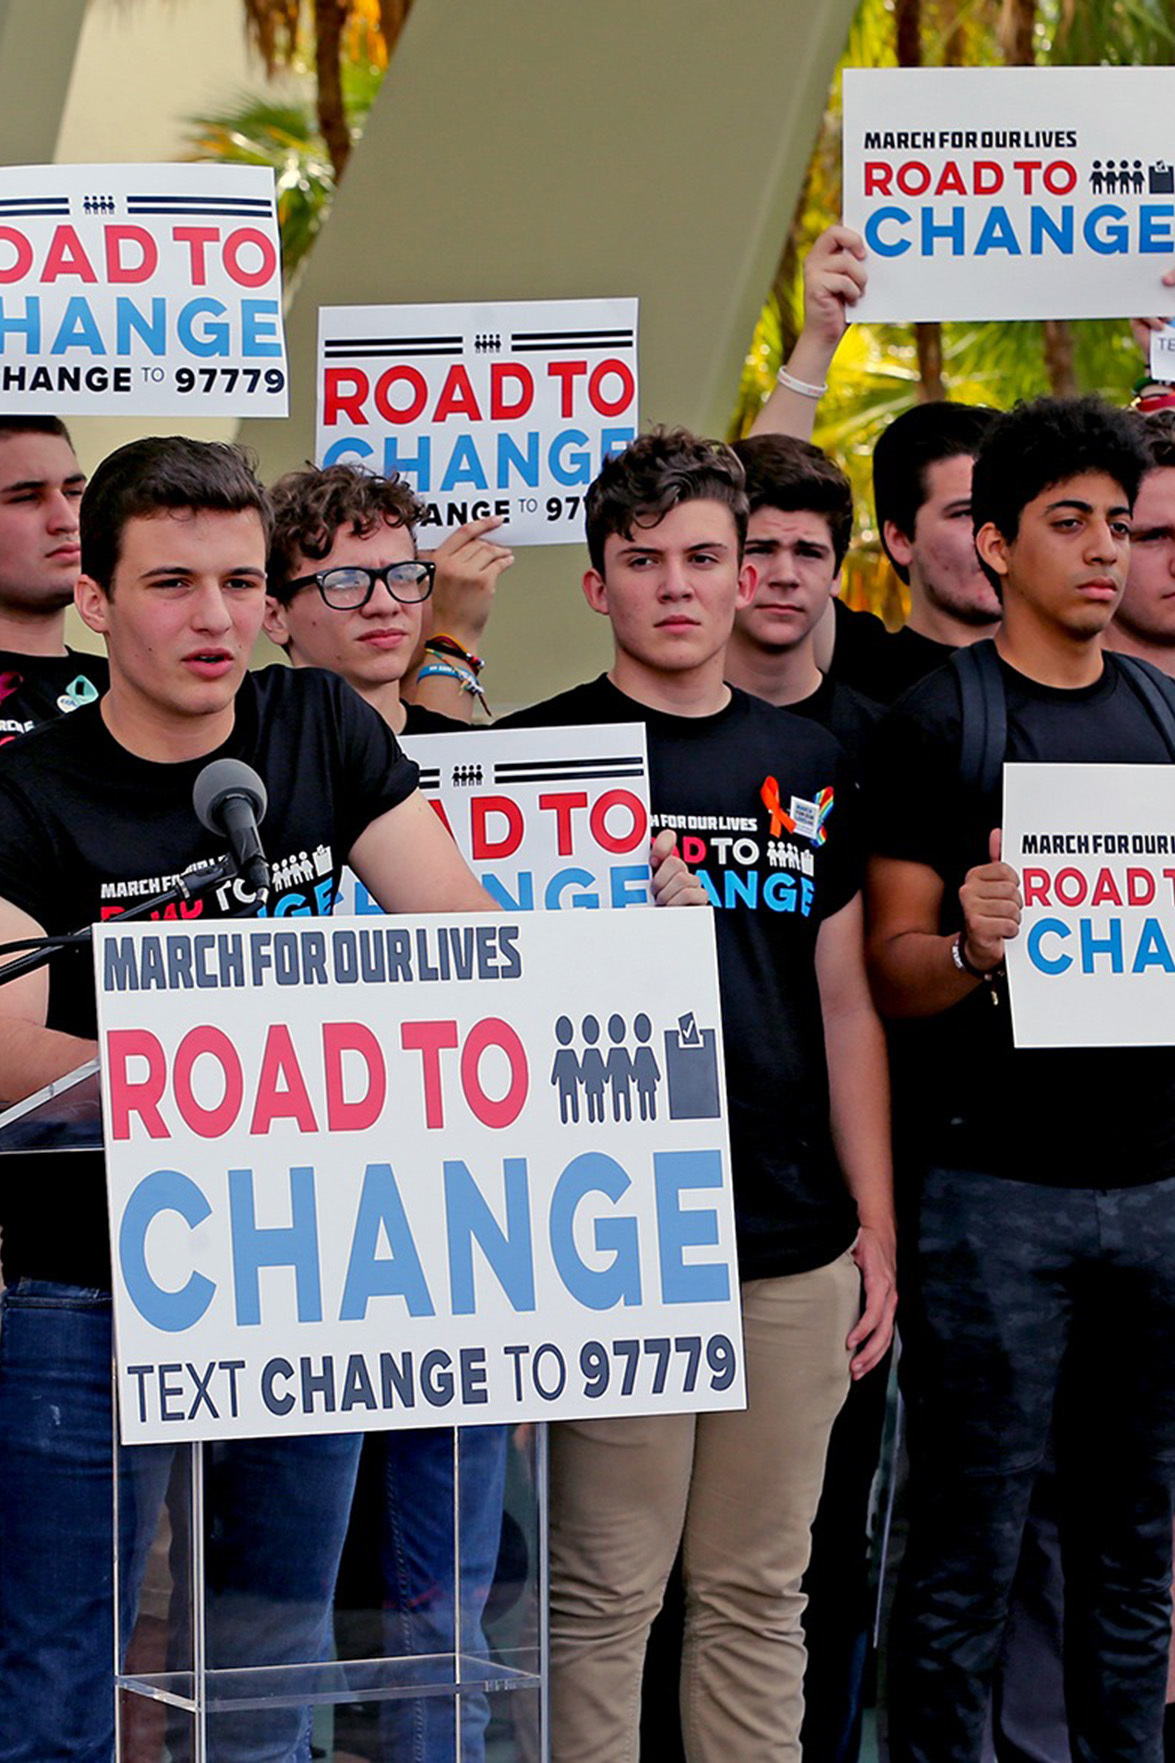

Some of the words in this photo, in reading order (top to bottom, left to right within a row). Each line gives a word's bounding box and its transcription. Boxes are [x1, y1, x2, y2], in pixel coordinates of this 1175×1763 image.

[864, 131, 936, 149] MARCH
[940, 131, 976, 149] FOR
[981, 131, 1022, 148] OUR
[1025, 130, 1077, 148] LIVES
[864, 161, 1004, 197] ROAD
[1013, 161, 1077, 196] TO
[864, 204, 1175, 257] CHANGE
[172, 226, 277, 289] TO
[141, 367, 165, 383] TO
[174, 367, 285, 393] 97779
[324, 362, 535, 426] ROAD
[547, 358, 635, 419] TO
[420, 499, 510, 527] ANGE
[518, 498, 538, 513] TO
[539, 788, 648, 857] TO
[660, 814, 687, 829] FOR
[688, 815, 718, 830] OUR
[719, 816, 758, 832] LIVES
[1022, 835, 1089, 854] MARCH
[1092, 835, 1129, 854] FOR
[1132, 835, 1169, 854] OUR
[710, 837, 760, 865] TO
[100, 877, 160, 899] MARCH
[694, 869, 815, 917] ANGE
[1022, 867, 1156, 907] ROAD
[104, 933, 245, 992] MARCH
[250, 930, 328, 987] FOR
[332, 928, 413, 985] OUR
[416, 926, 522, 982] LIVES
[107, 1021, 387, 1141] ROAD
[400, 1017, 529, 1131] TO
[119, 1149, 732, 1333] CHANGE
[127, 1360, 246, 1423] TEXT
[260, 1347, 489, 1418] CHANGE
[503, 1342, 567, 1403] TO
[578, 1333, 737, 1399] 97779
